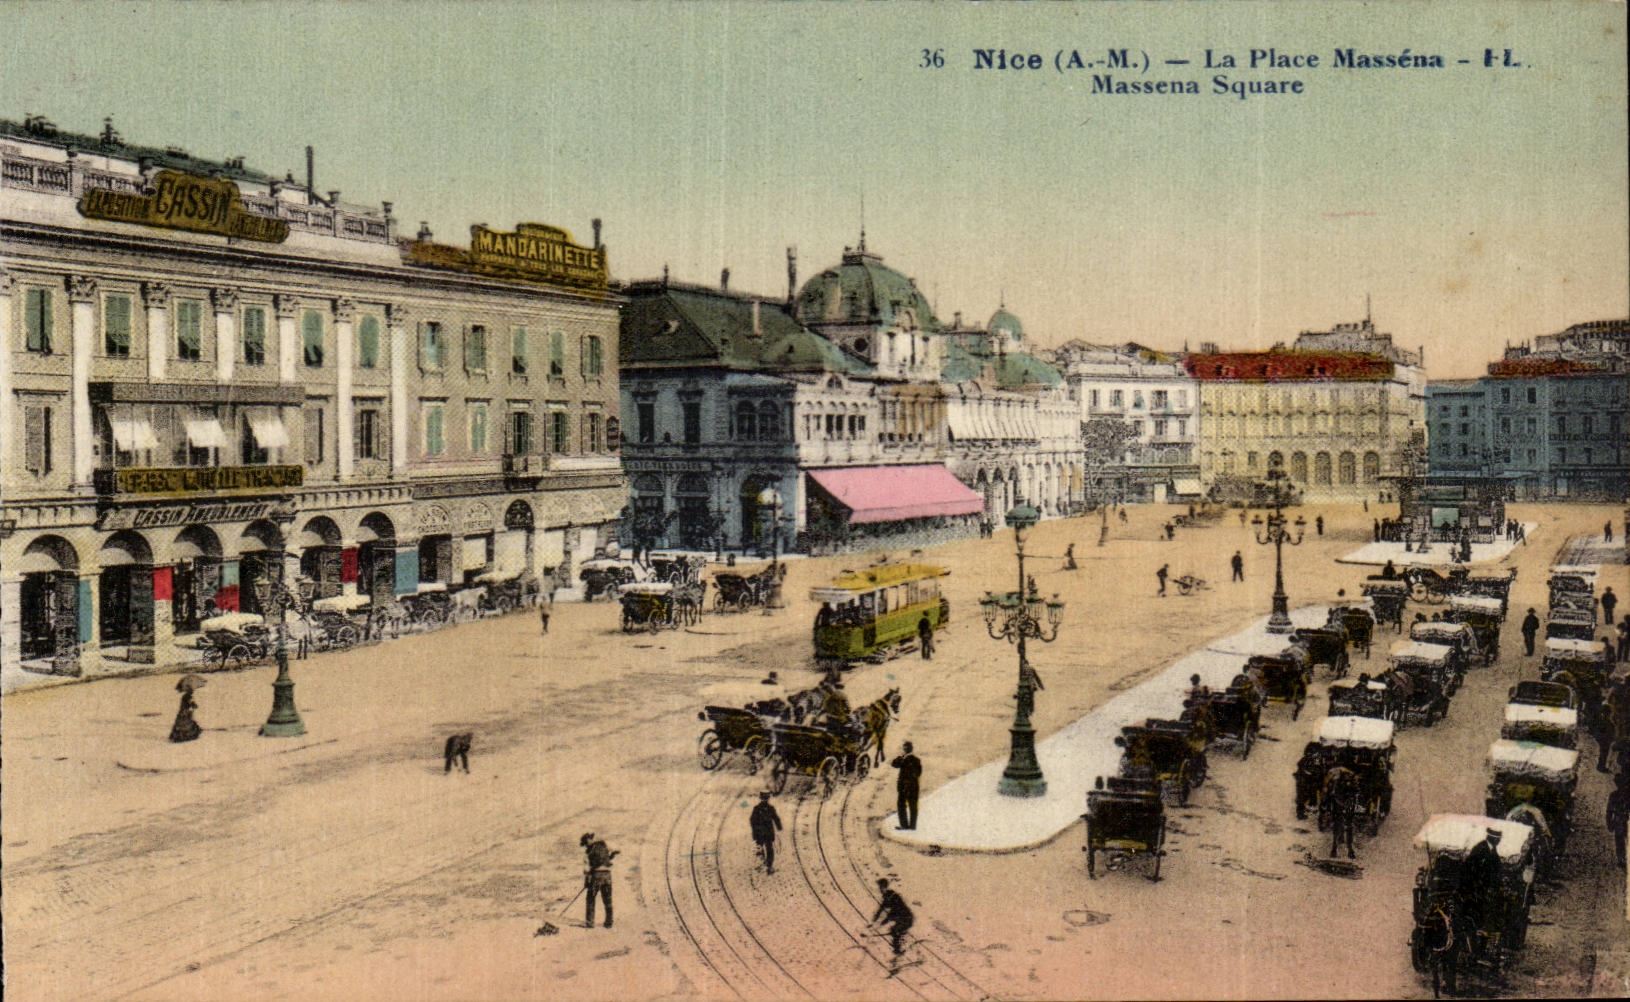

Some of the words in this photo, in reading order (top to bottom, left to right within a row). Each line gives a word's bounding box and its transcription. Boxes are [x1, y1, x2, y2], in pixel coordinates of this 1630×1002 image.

[155, 176, 233, 227] CASSIN
[479, 230, 600, 270] MANDARINETTE
[134, 507, 185, 527] CASSIN
